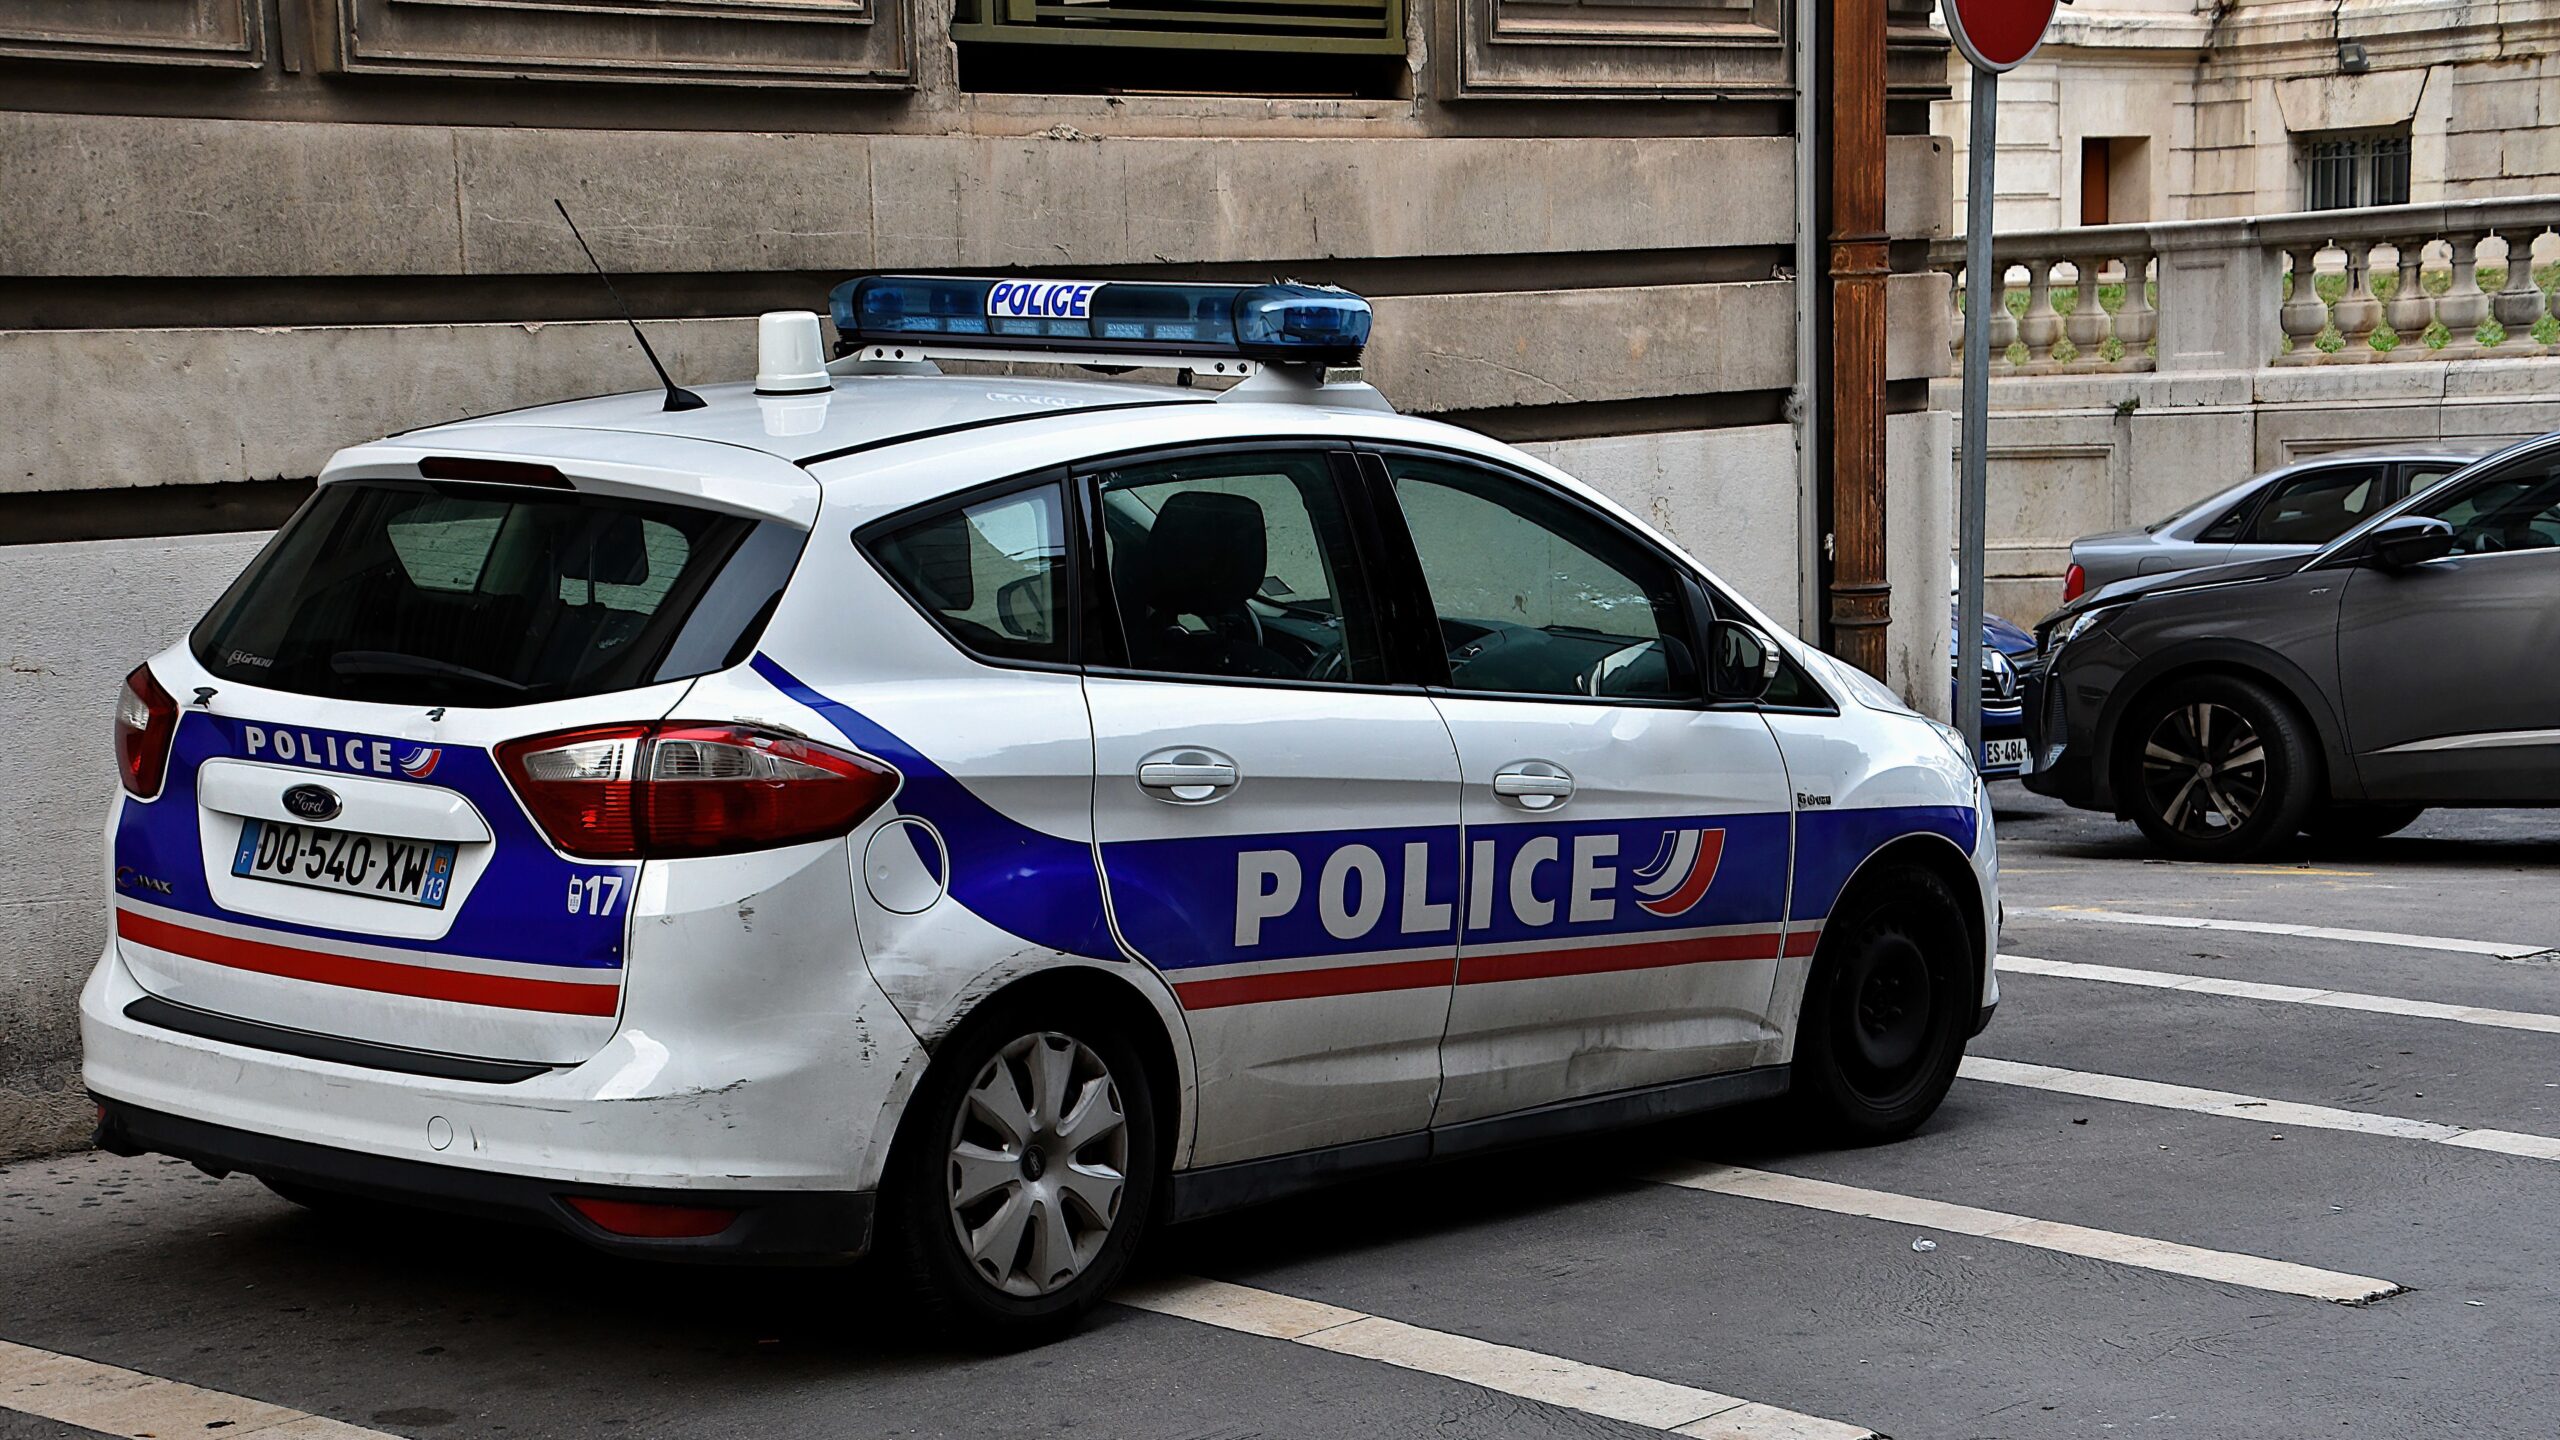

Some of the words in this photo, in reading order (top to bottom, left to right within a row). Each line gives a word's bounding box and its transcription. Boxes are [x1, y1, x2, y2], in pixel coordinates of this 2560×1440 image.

[991, 283, 1095, 316] POLICE
[245, 726, 392, 773] POLICE
[292, 790, 324, 813] Ford
[240, 851, 249, 864] F
[256, 824, 429, 895] DQ-540-XW
[426, 877, 445, 901] 13
[585, 875, 623, 916] 17
[1235, 834, 1619, 946] POLICE
